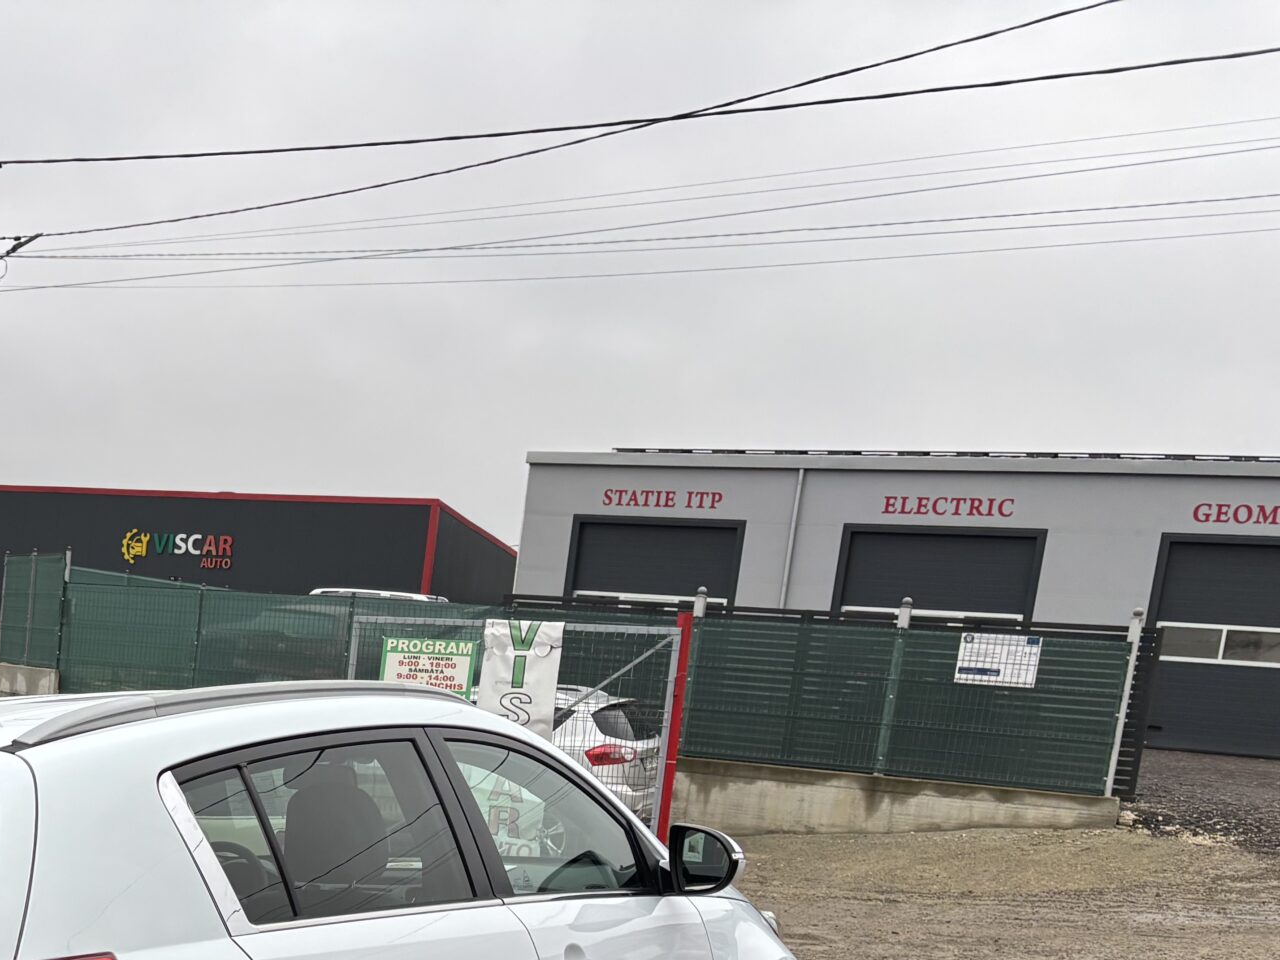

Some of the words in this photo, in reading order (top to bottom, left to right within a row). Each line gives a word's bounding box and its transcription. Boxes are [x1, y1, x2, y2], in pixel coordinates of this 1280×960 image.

[602, 488, 676, 508] STATIE
[685, 491, 723, 509] ITP
[881, 496, 1015, 517] ELECTRIC
[1192, 503, 1280, 525] GEOM
[153, 533, 233, 556] VISCAR
[200, 558, 231, 569] AUTO
[386, 640, 473, 655] PROGRAM
[398, 660, 420, 668] 9:00
[429, 662, 457, 670] 18:00
[396, 673, 418, 681] 9:00
[428, 675, 455, 683] 14:00
